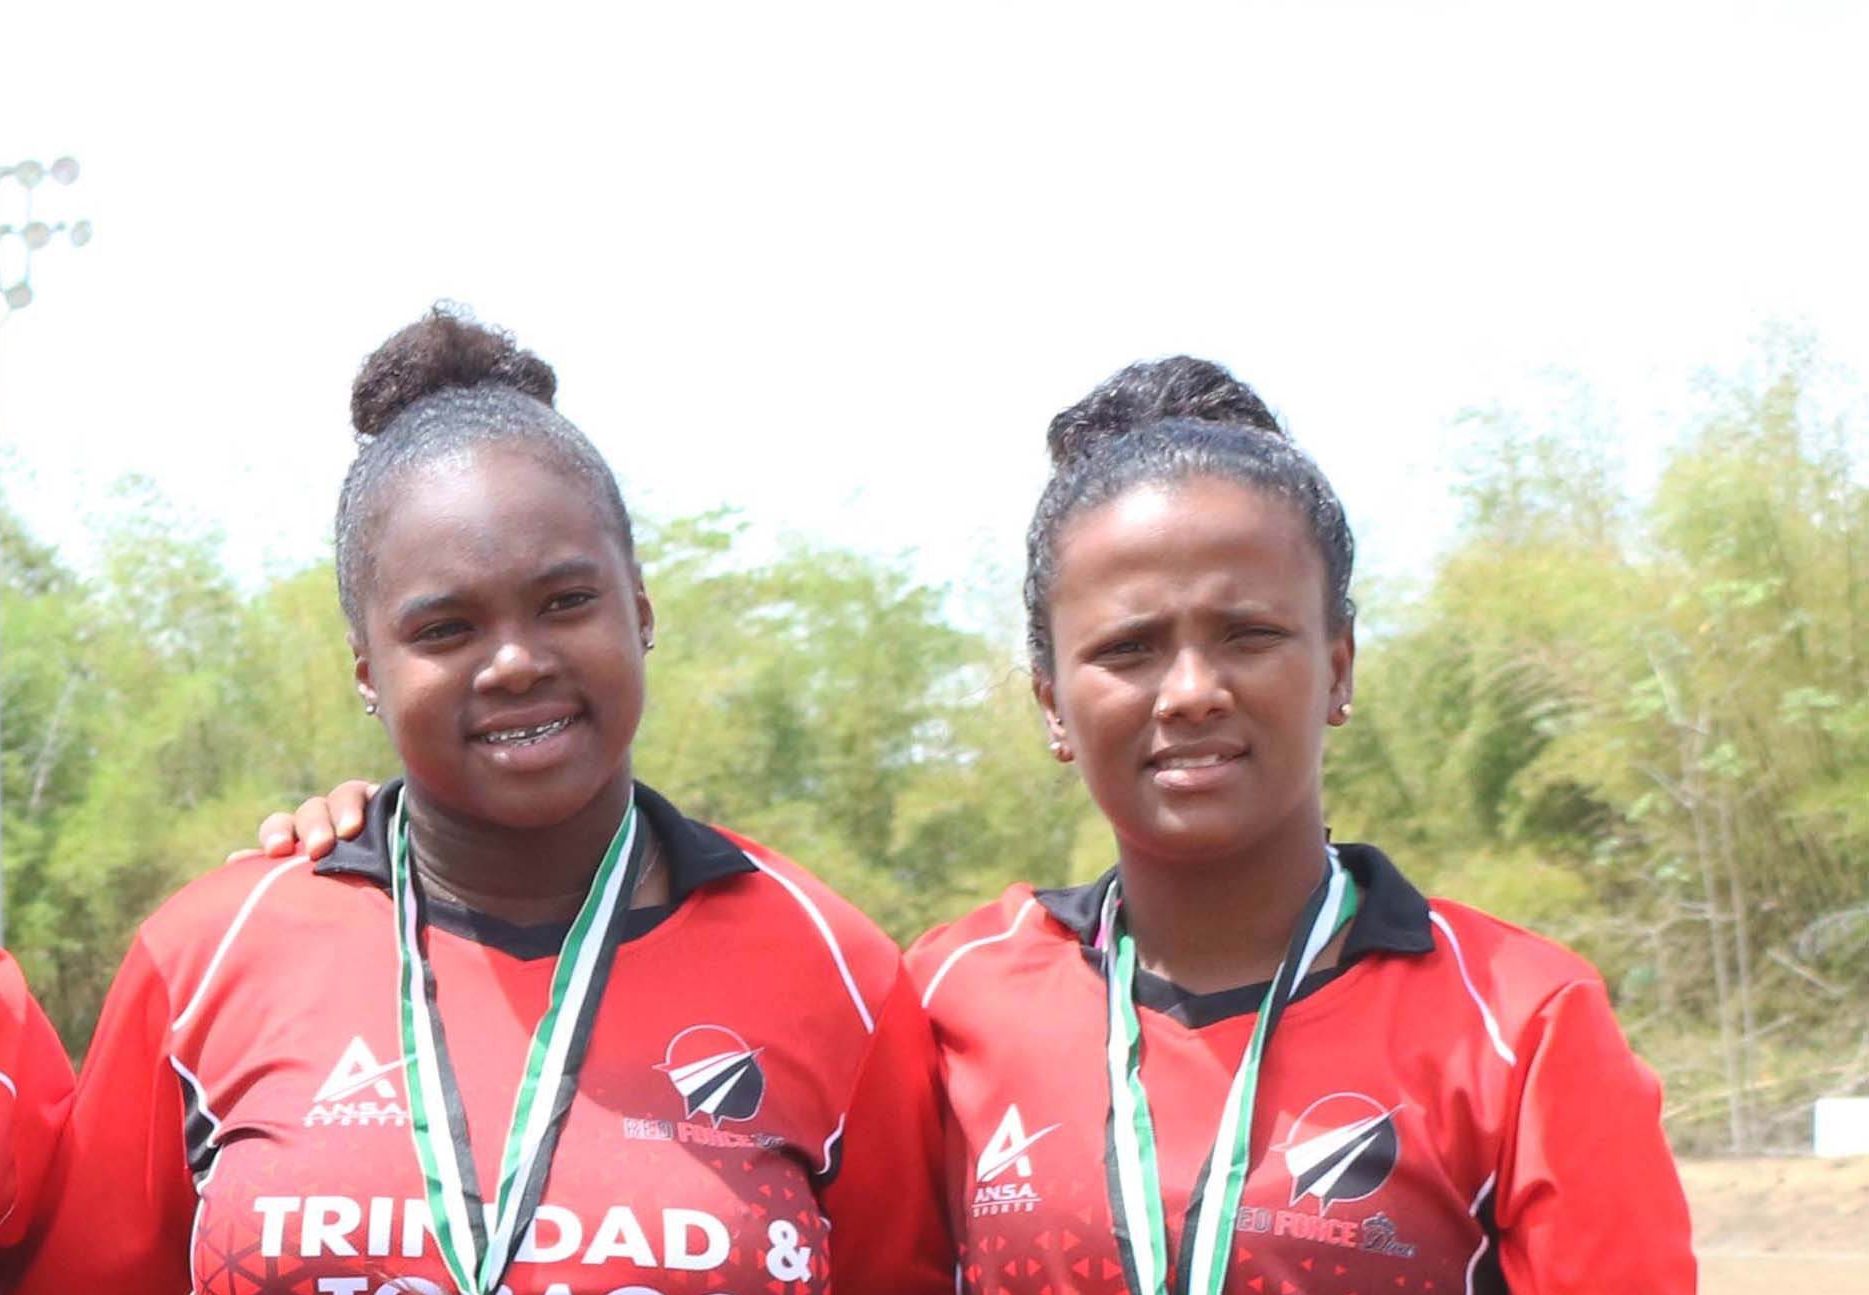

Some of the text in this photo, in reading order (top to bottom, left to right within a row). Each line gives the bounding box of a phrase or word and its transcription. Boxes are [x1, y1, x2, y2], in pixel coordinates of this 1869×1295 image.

[765, 1219, 812, 1282] &
[1236, 1206, 1271, 1233] ED
[1274, 1210, 1359, 1248] FORCE
